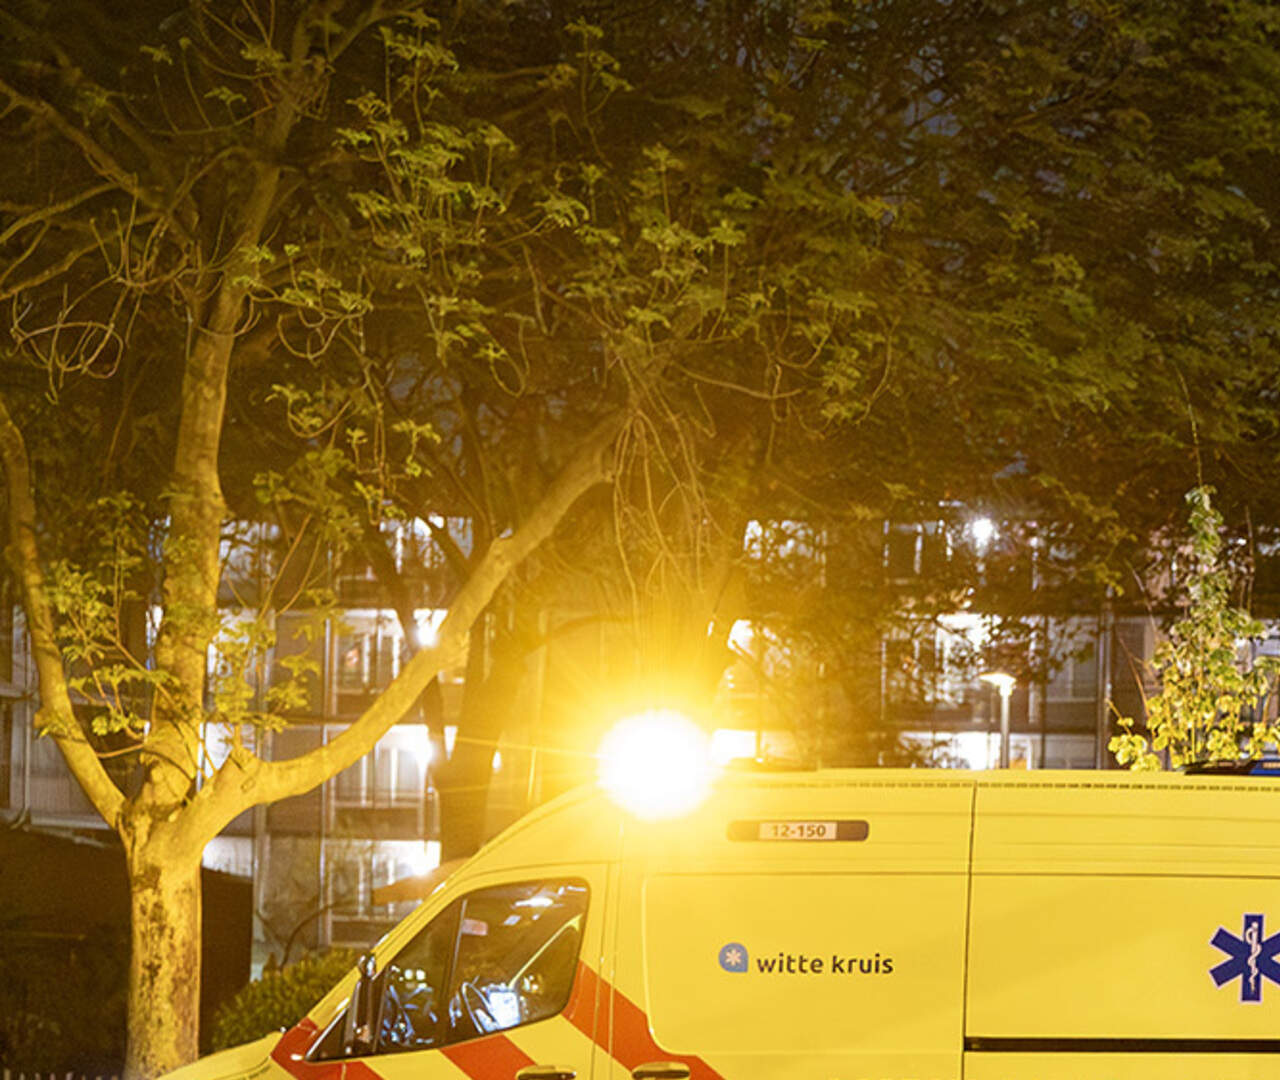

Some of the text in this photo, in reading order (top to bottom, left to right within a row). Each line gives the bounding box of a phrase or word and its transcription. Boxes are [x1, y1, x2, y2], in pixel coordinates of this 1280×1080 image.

[772, 825, 826, 838] 12-150
[757, 952, 894, 974] witte kruis
